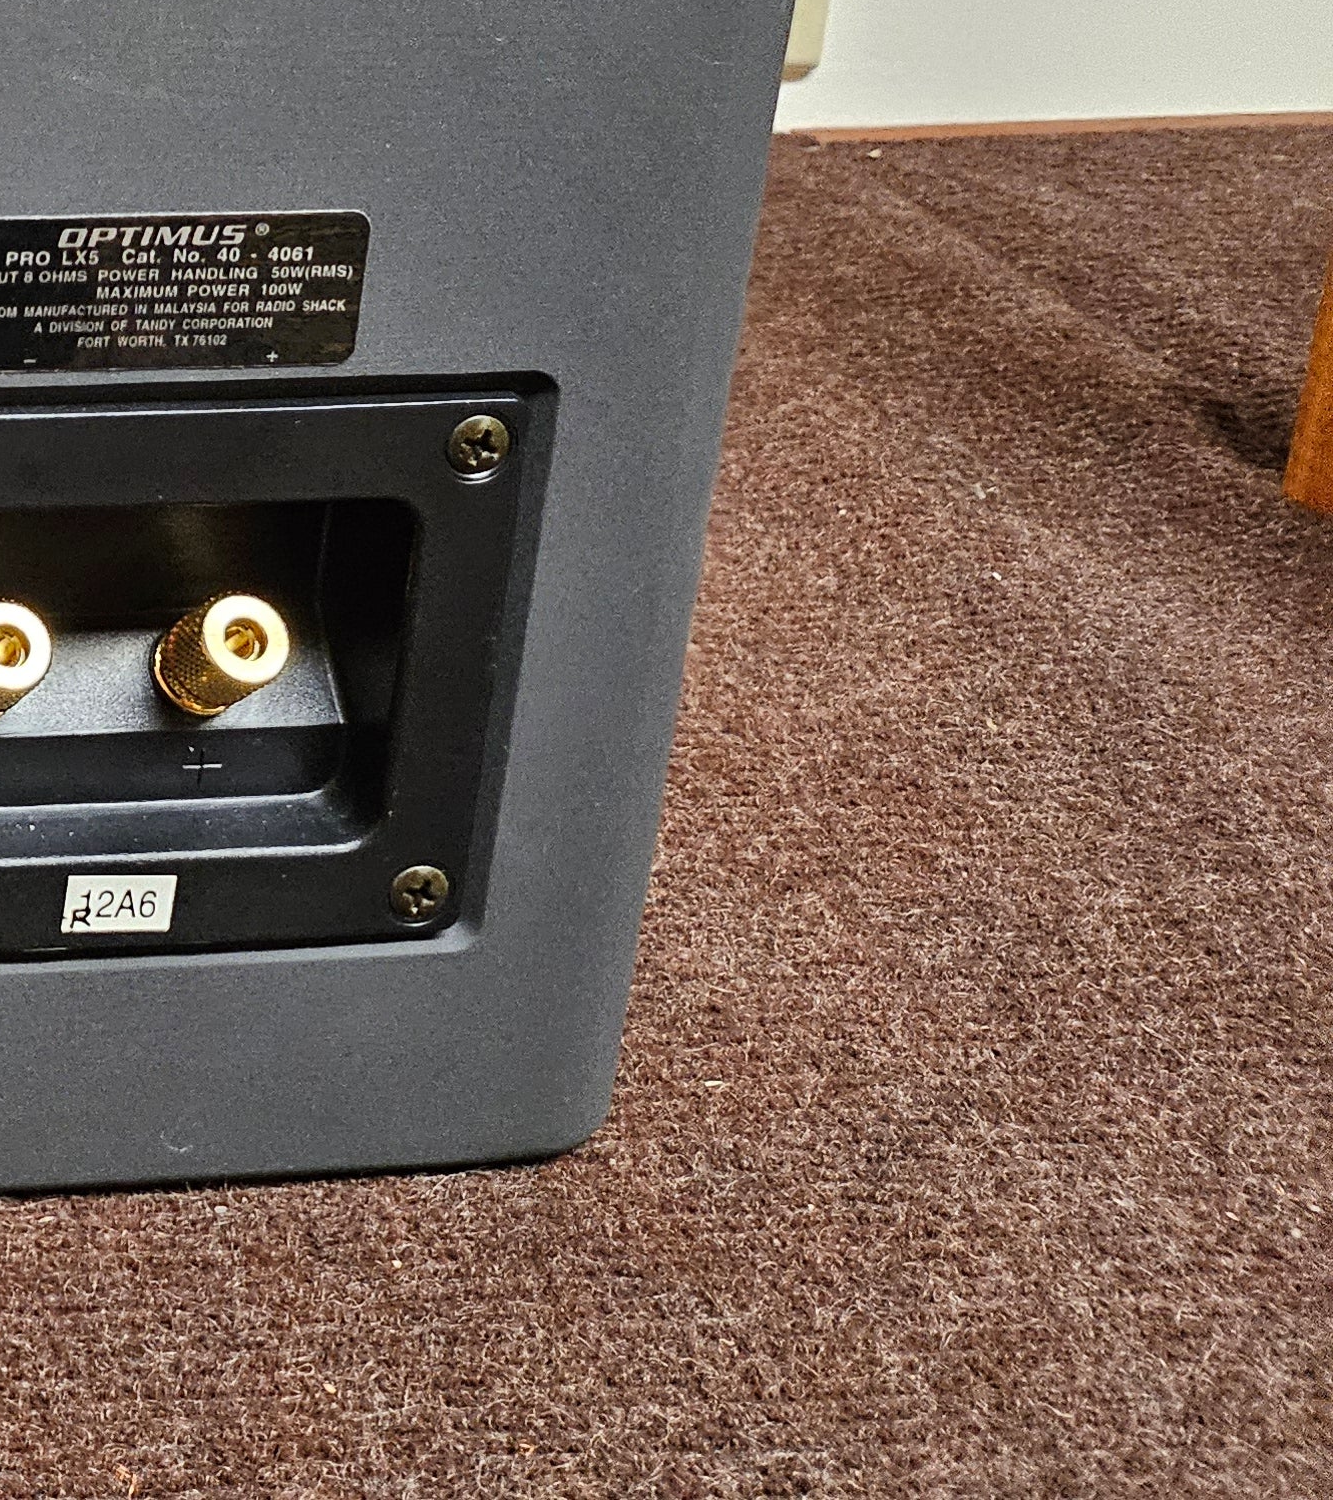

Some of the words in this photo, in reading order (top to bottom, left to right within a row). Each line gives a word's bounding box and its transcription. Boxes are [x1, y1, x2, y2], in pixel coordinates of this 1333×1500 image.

[58, 225, 247, 248] OPTIMUS
[6, 251, 50, 266] PRO
[62, 250, 99, 265] LX5
[122, 249, 160, 264] Cat.
[173, 248, 205, 263] No.
[217, 247, 240, 262] 40
[268, 247, 313, 261] 4061
[24, 271, 33, 283] 8
[39, 271, 87, 282] OHMS
[98, 269, 159, 281] POWER
[171, 267, 257, 280] HANDLING
[272, 265, 353, 280] 50W(RMS)
[97, 286, 177, 299] MAXIMUM
[187, 284, 249, 297] POWER
[262, 283, 302, 295] 100W
[24, 304, 128, 317] MANUFACTURED
[135, 304, 147, 314] IN
[154, 302, 216, 314] MALAYSIA
[223, 302, 249, 312] FOR
[256, 300, 295, 311] RADIO
[303, 299, 345, 311] SHACK
[34, 322, 42, 333] A
[49, 321, 104, 333] DIVISION
[111, 320, 127, 331] OF
[136, 319, 175, 330] TANDY
[183, 317, 273, 329] CORPORATION
[77, 336, 110, 348] FORT
[175, 335, 188, 346] TX
[193, 334, 227, 346] 76102
[81, 889, 157, 918] 12A6
